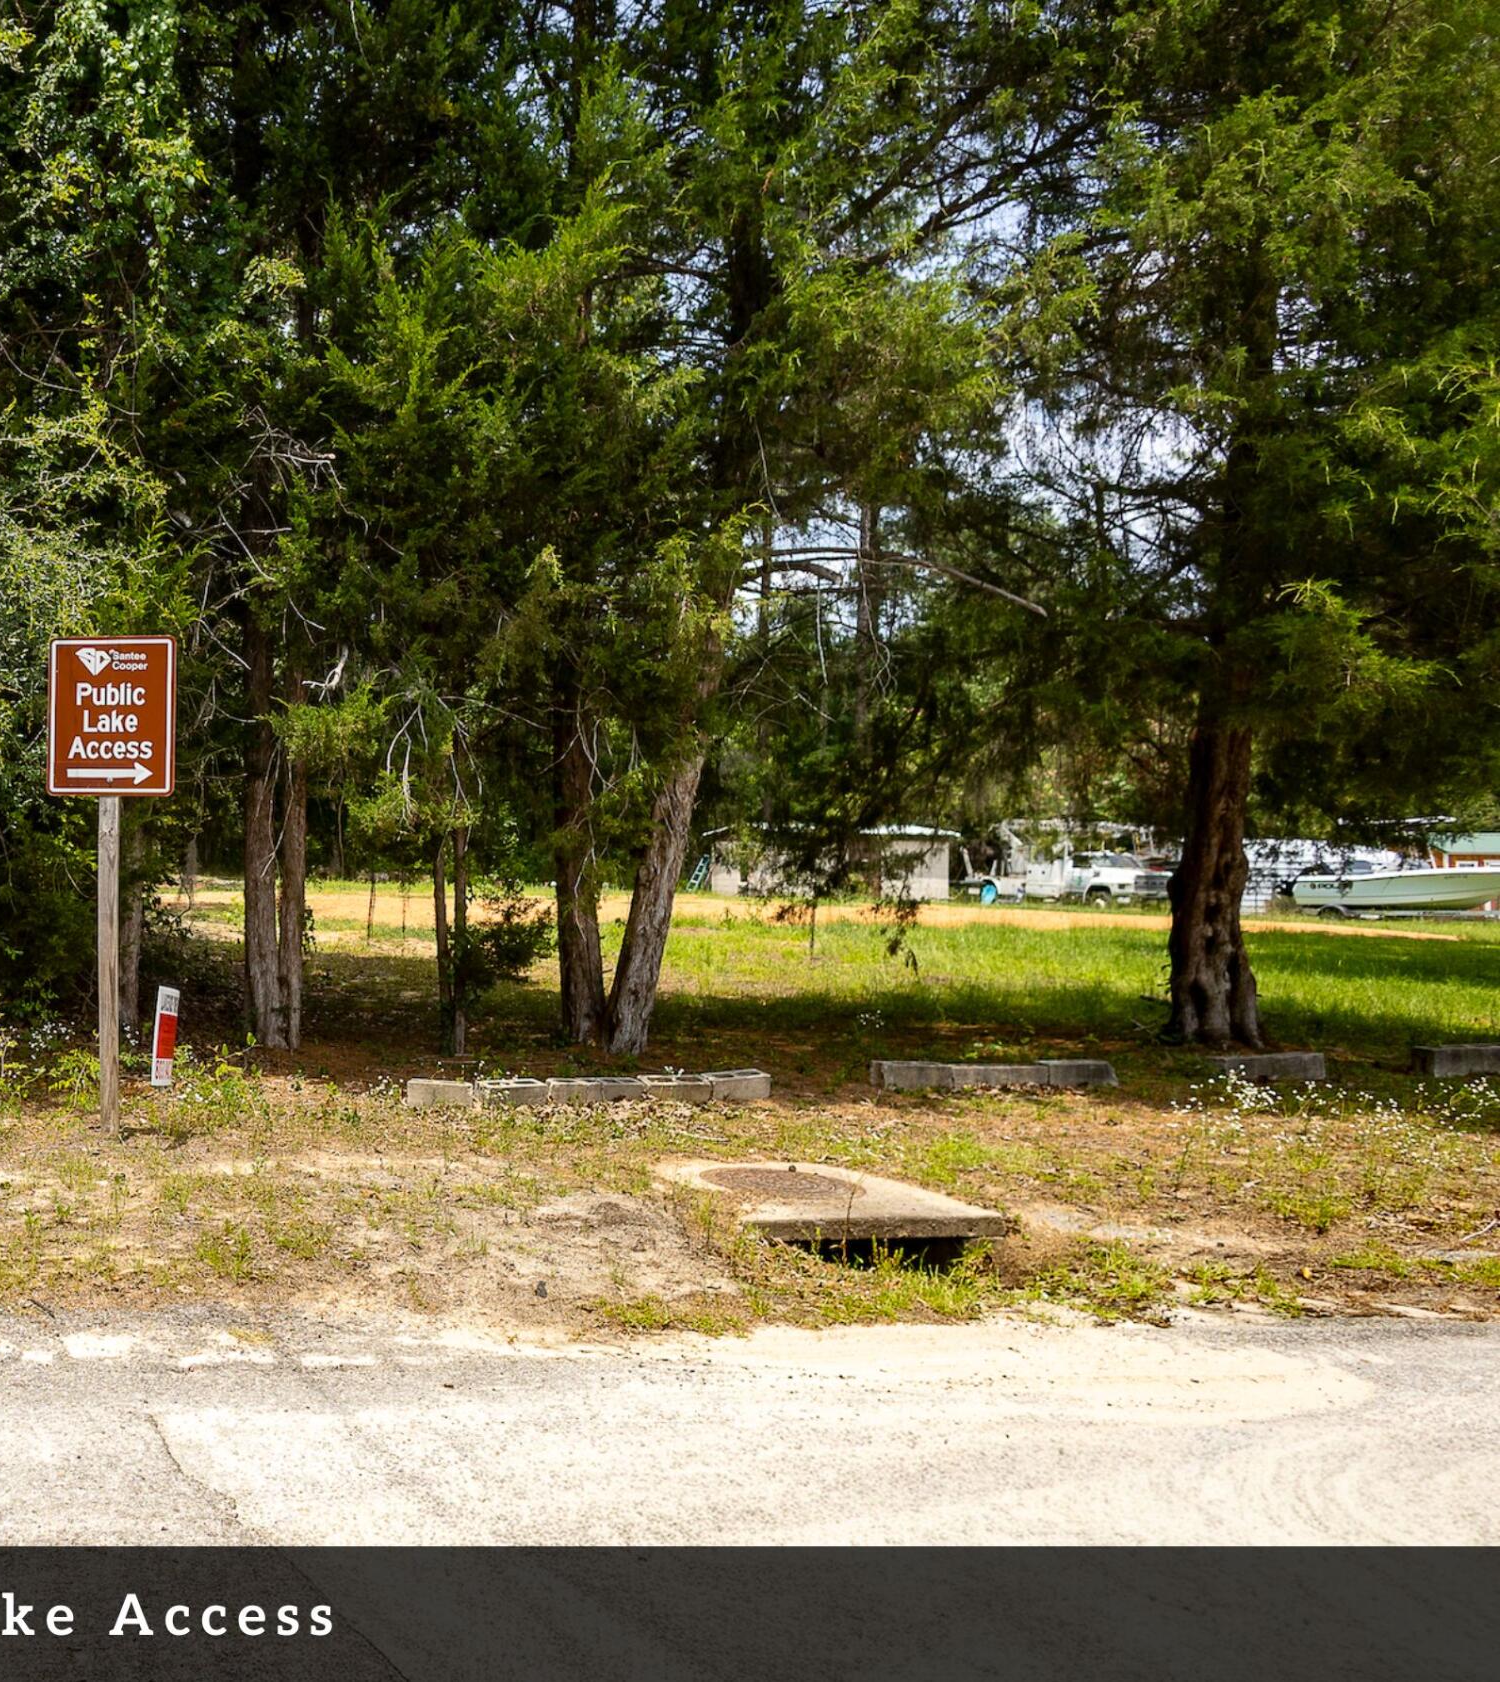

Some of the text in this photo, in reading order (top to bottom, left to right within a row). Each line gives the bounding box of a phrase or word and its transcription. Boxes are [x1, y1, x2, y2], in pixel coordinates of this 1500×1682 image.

[112, 661, 148, 671] Cooper
[76, 682, 146, 706] Public
[83, 709, 139, 733] Lake
[67, 736, 154, 760] Access
